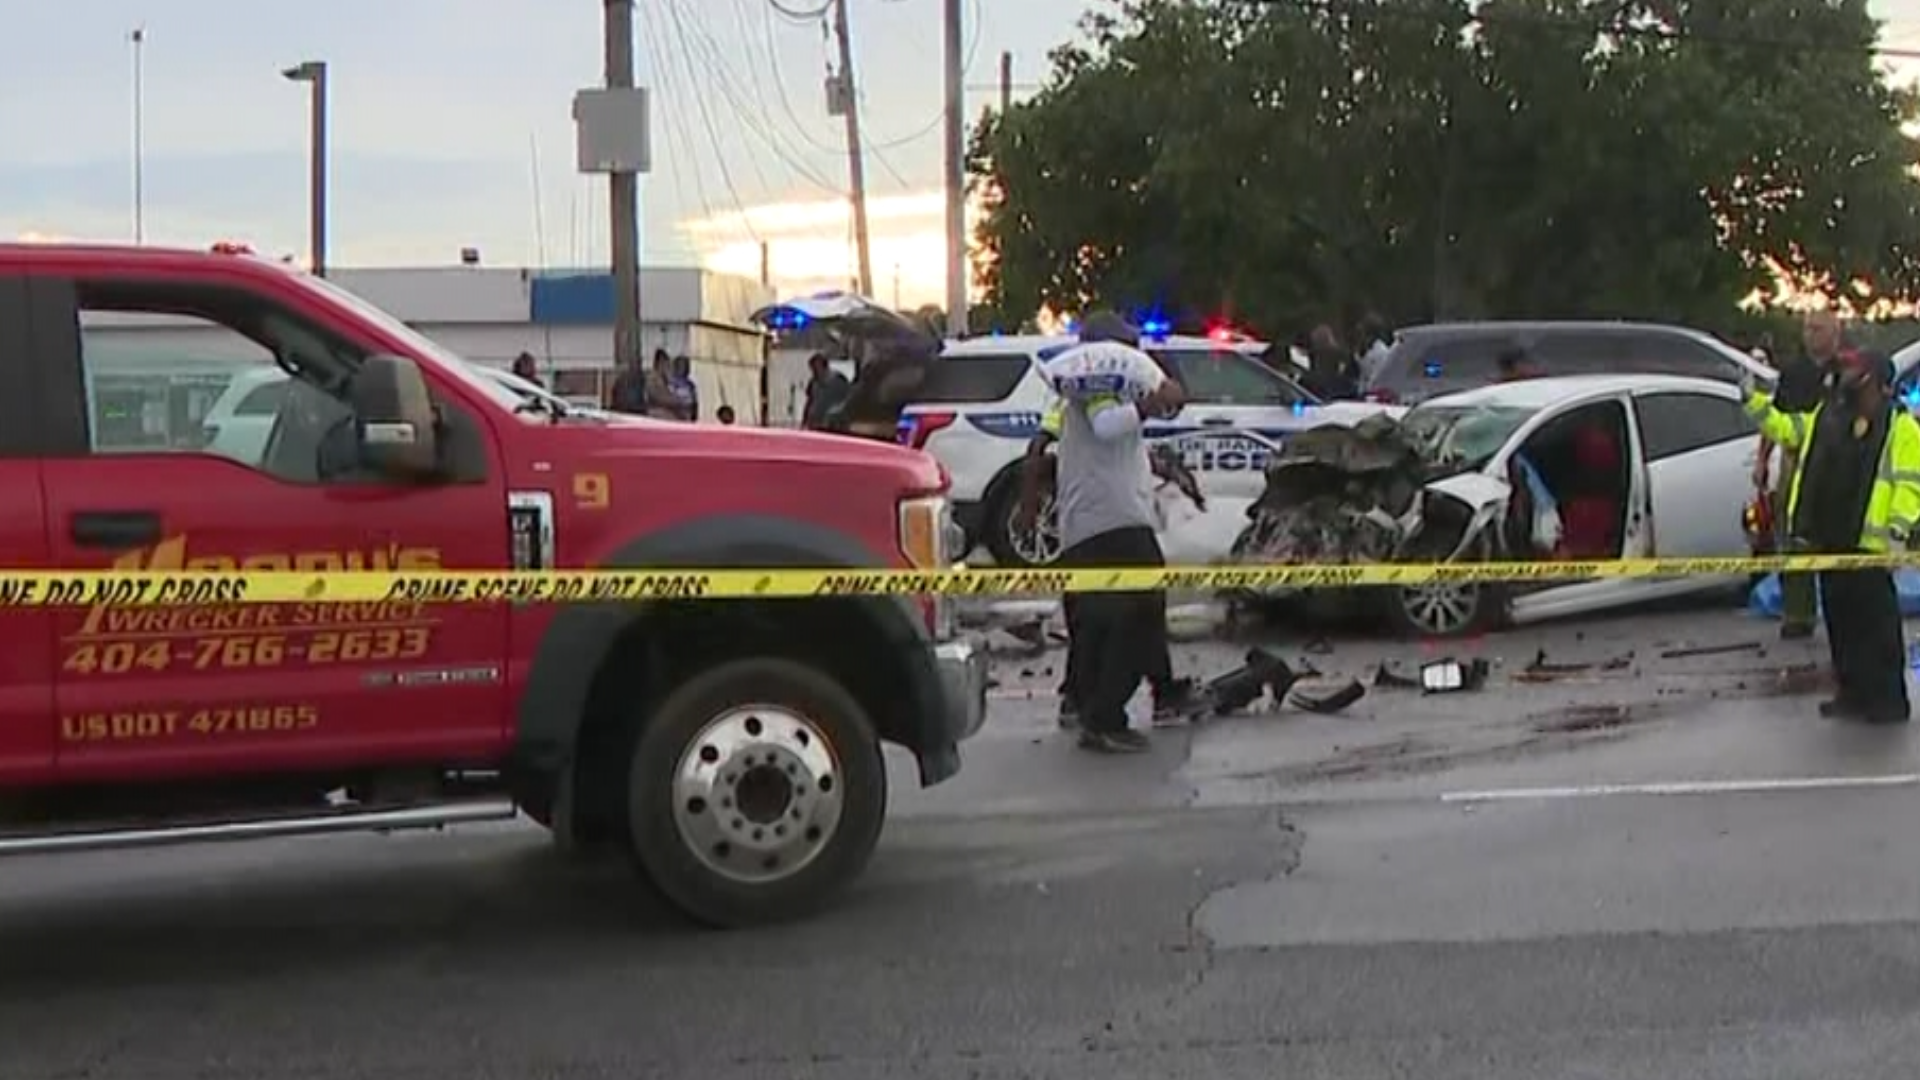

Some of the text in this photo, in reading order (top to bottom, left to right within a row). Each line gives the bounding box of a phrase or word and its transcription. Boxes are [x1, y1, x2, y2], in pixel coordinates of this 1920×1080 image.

[573, 473, 609, 509] 9
[43, 578, 86, 604] DO
[91, 578, 151, 603] NOT
[155, 577, 247, 603] CROSS
[385, 577, 468, 602] CRIME
[472, 576, 547, 602] SCENE
[107, 596, 424, 631] WRECKER SERVICE
[61, 628, 430, 674] 404-766-2633
